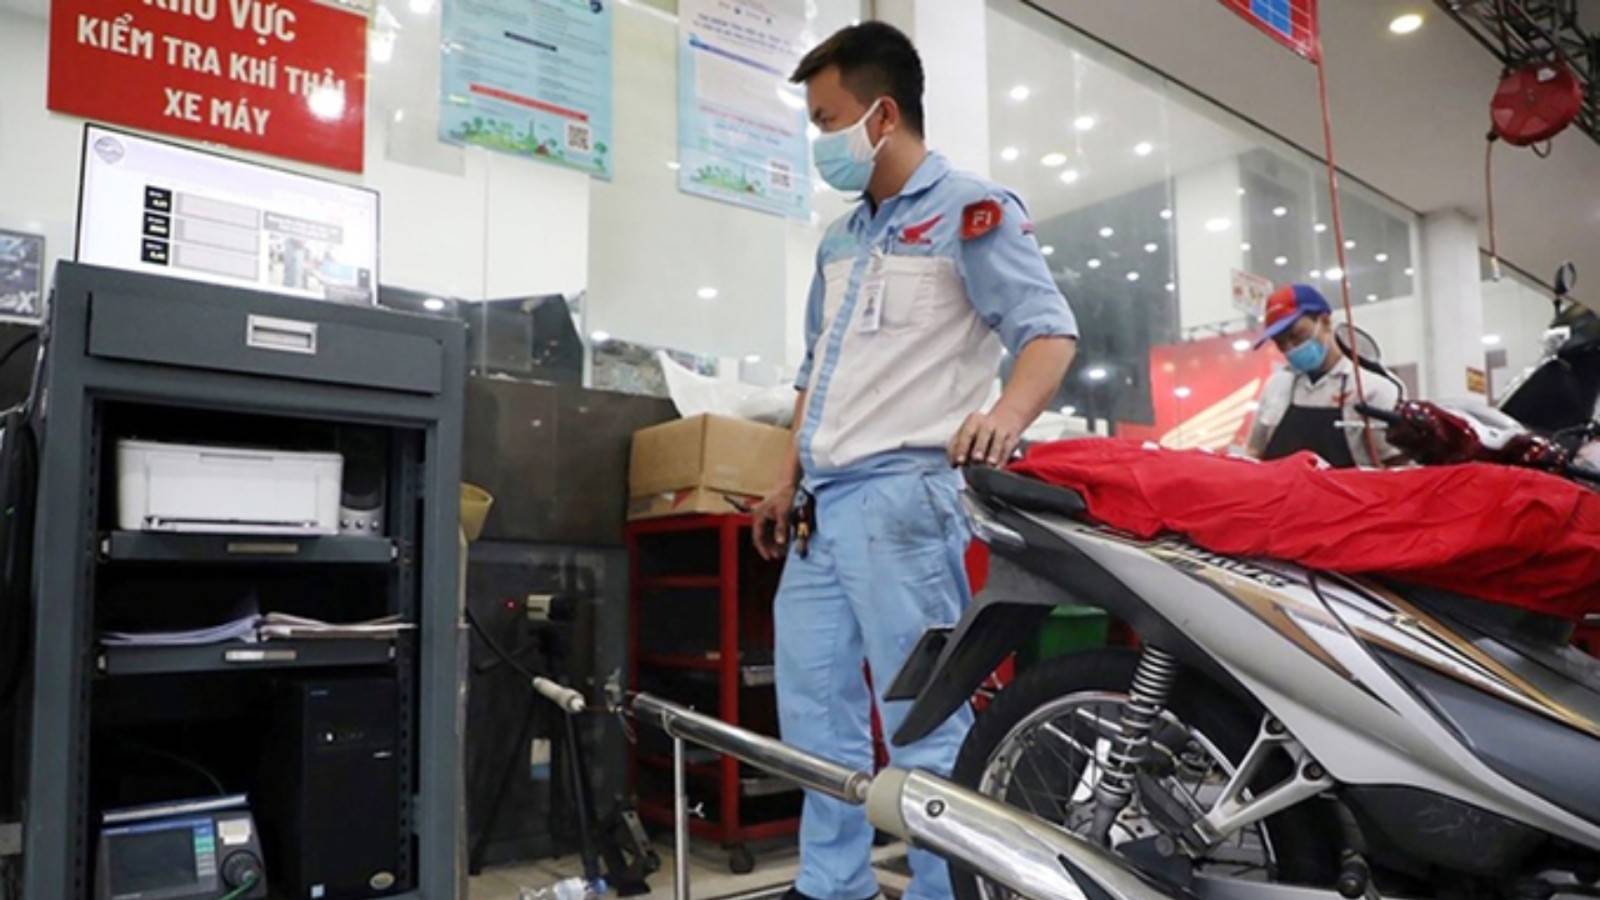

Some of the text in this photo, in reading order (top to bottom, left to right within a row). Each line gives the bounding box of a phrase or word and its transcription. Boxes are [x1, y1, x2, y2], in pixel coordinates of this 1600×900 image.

[229, 0, 296, 46] VỰC
[77, 13, 154, 60] KIỂM
[162, 35, 222, 77] TRA
[229, 52, 278, 90] KHÍ
[163, 87, 271, 136] XE MÁY
